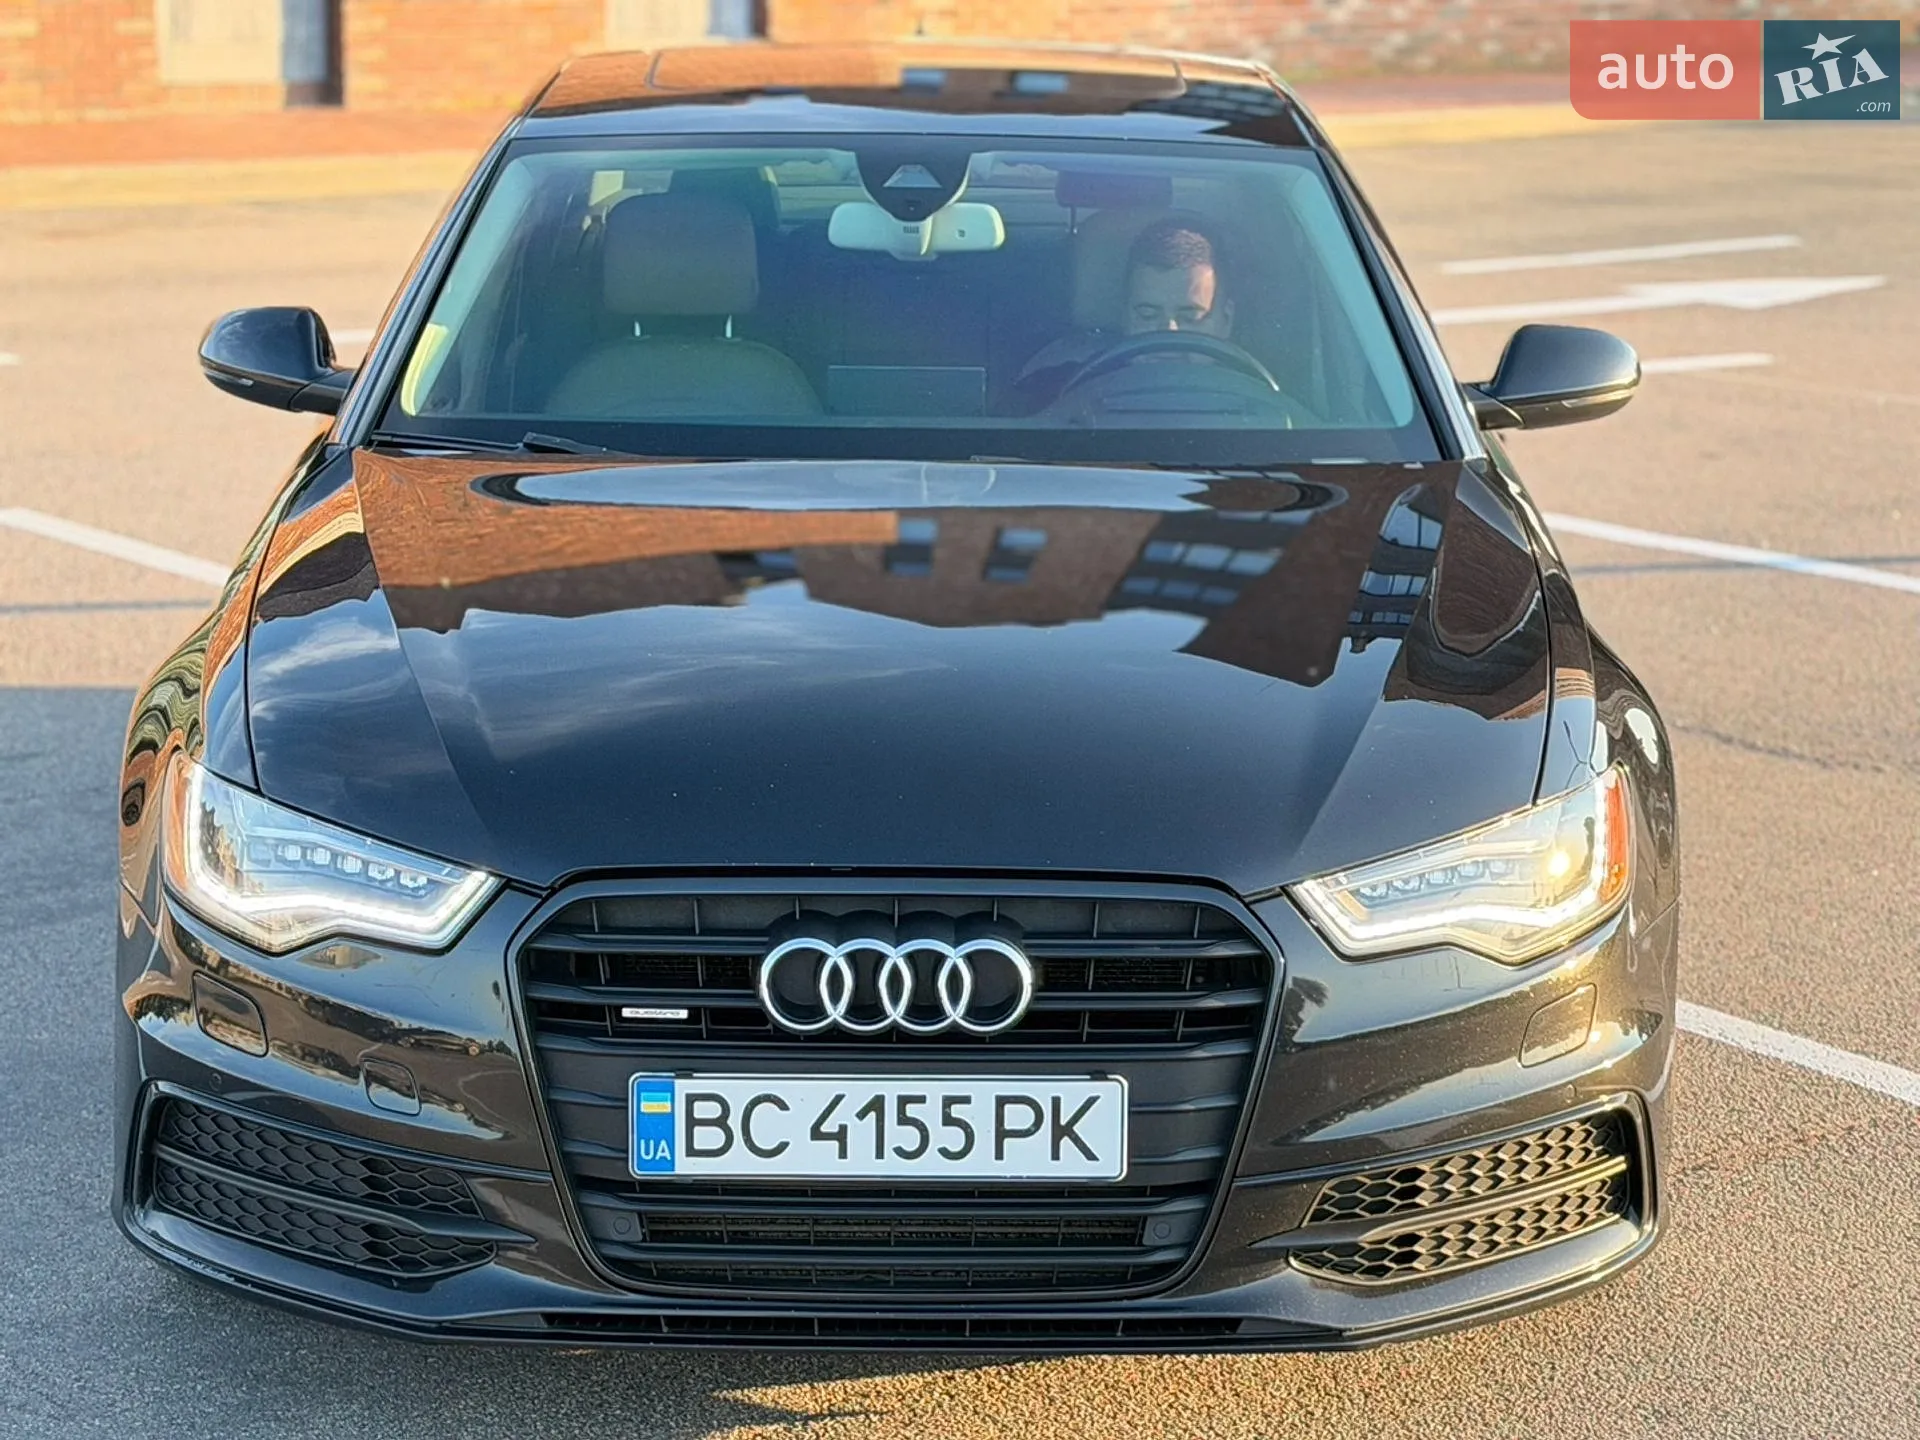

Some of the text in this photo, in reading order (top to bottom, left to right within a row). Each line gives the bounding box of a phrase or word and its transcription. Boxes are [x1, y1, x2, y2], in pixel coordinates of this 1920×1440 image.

[639, 1139, 672, 1161] UA
[684, 1093, 1101, 1162] BC 4155 PK
